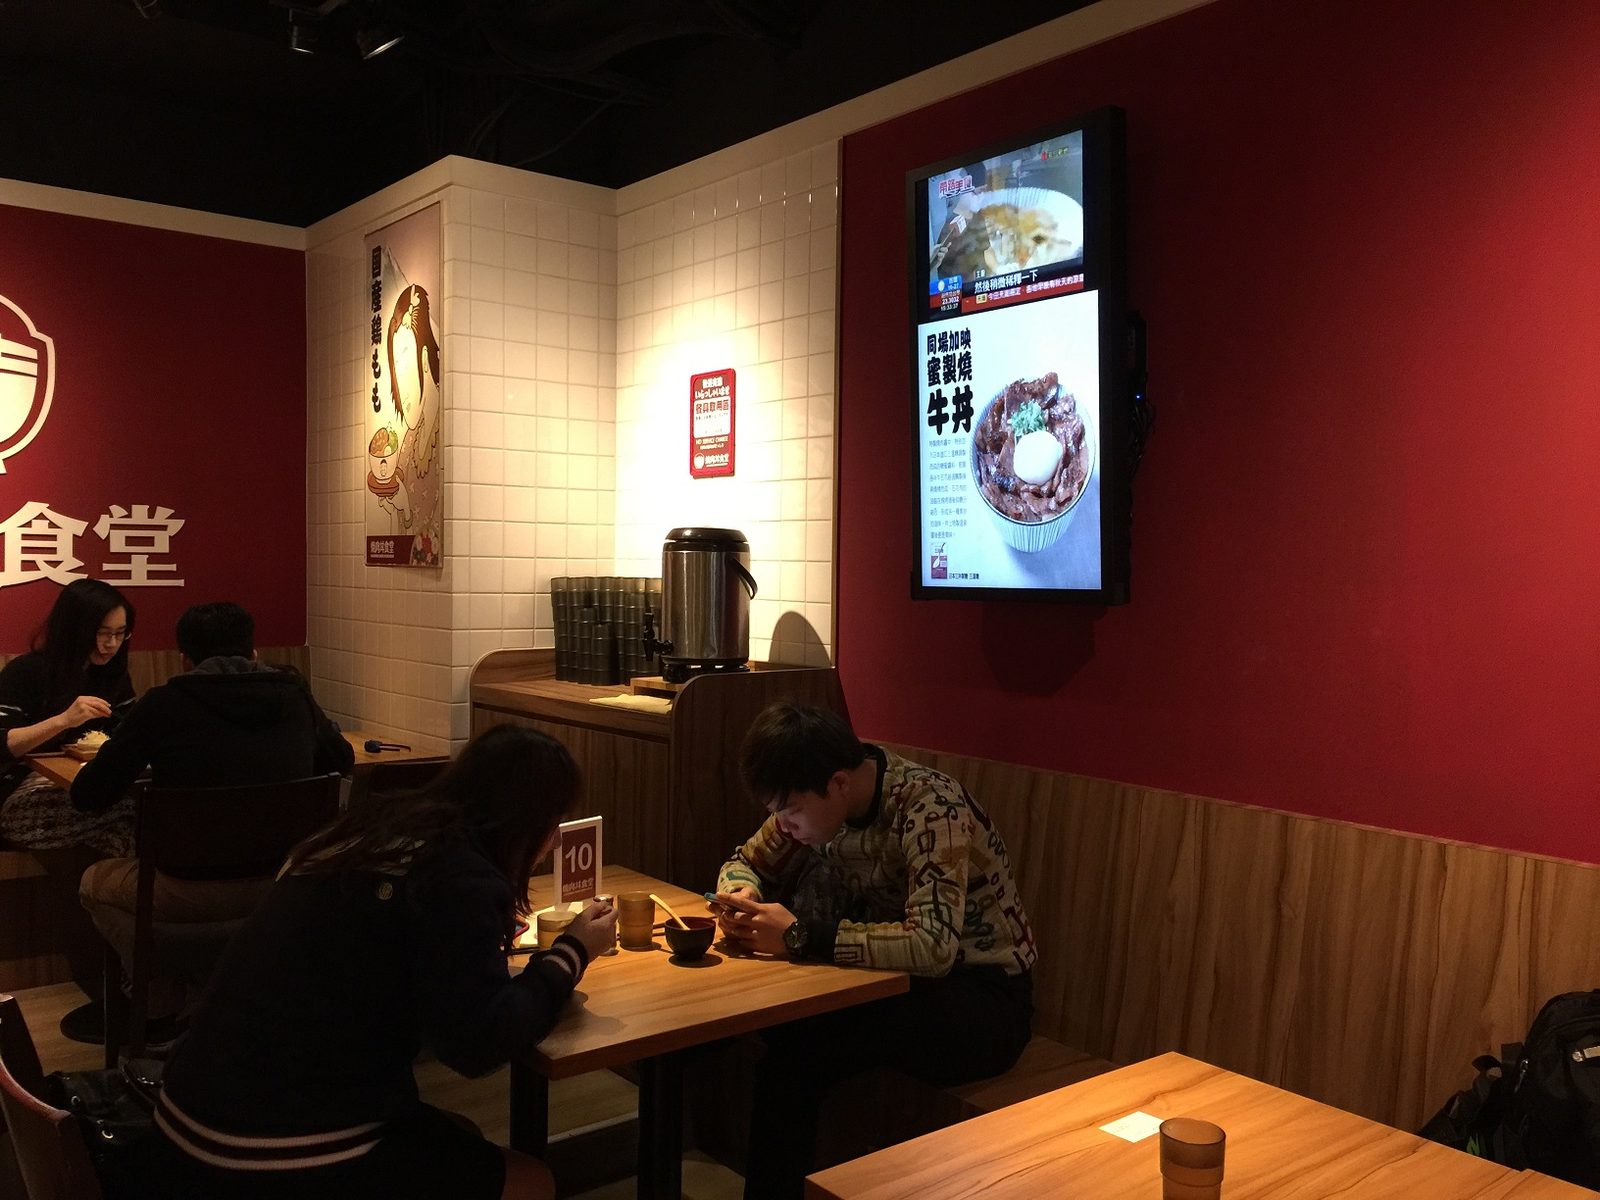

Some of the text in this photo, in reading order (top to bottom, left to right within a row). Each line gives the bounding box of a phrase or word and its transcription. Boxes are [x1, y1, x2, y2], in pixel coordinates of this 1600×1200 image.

[926, 327, 972, 356] 同場加映
[927, 351, 973, 387] 蜜製燒
[927, 385, 974, 436] 牛丼
[565, 842, 593, 873] 10
